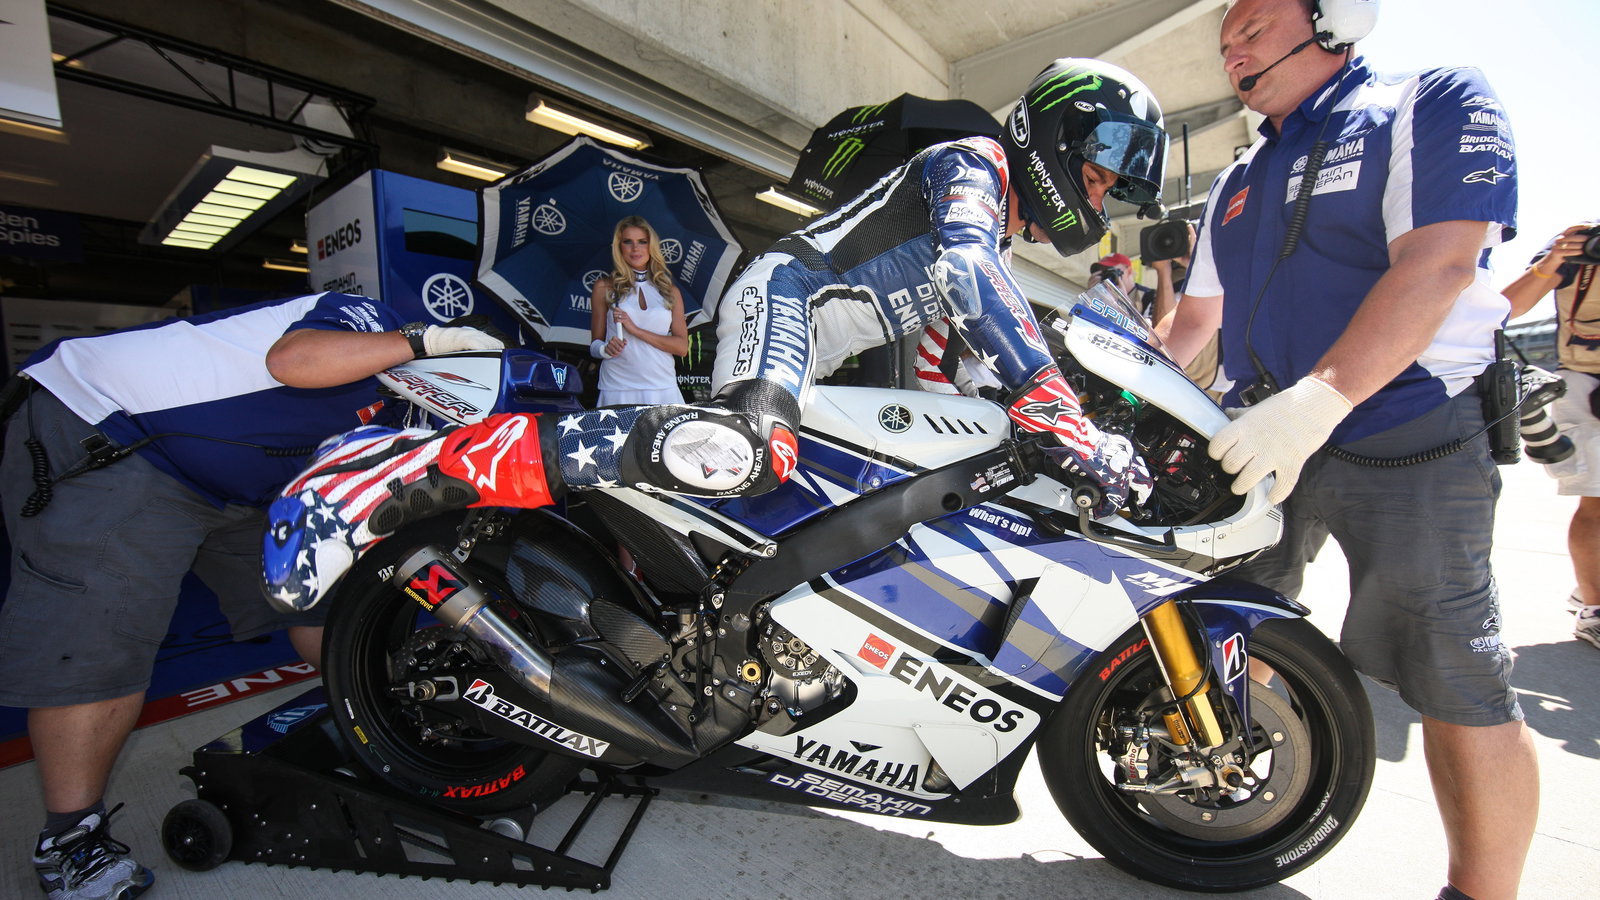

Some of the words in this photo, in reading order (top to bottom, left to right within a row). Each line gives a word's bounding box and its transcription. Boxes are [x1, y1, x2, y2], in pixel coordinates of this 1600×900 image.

[1322, 137, 1364, 163] MAHA
[602, 157, 660, 181] YAMAHA
[1029, 150, 1066, 212] MONSTER
[1027, 167, 1051, 207] ENERGY
[0, 210, 39, 229] Ben
[0, 226, 60, 247] Spies
[513, 196, 531, 247] YAMAHA
[324, 218, 362, 257] ENEOS
[680, 239, 705, 283] YAMAHA
[570, 294, 592, 310] YAM
[763, 294, 806, 387] YAMAHA
[677, 374, 711, 384] ONSTER
[664, 411, 699, 431] RACING
[651, 431, 666, 462] AHEAD
[749, 448, 764, 482] AHEAD
[716, 480, 751, 496] RACING
[968, 508, 1010, 528] What's
[1010, 522, 1033, 537] up!
[864, 642, 890, 661] ENEOS
[889, 652, 1025, 733] ENEOS
[490, 699, 605, 756] BATTLAX
[793, 735, 920, 792] YAMAHA
[1129, 748, 1137, 779] brembo
[442, 764, 526, 798] BATTLAX
[770, 773, 803, 789] DI
[805, 786, 905, 817] DEPAN
[800, 772, 932, 815] SEMAKIN
[1275, 815, 1339, 867] BRIDGESTONE
